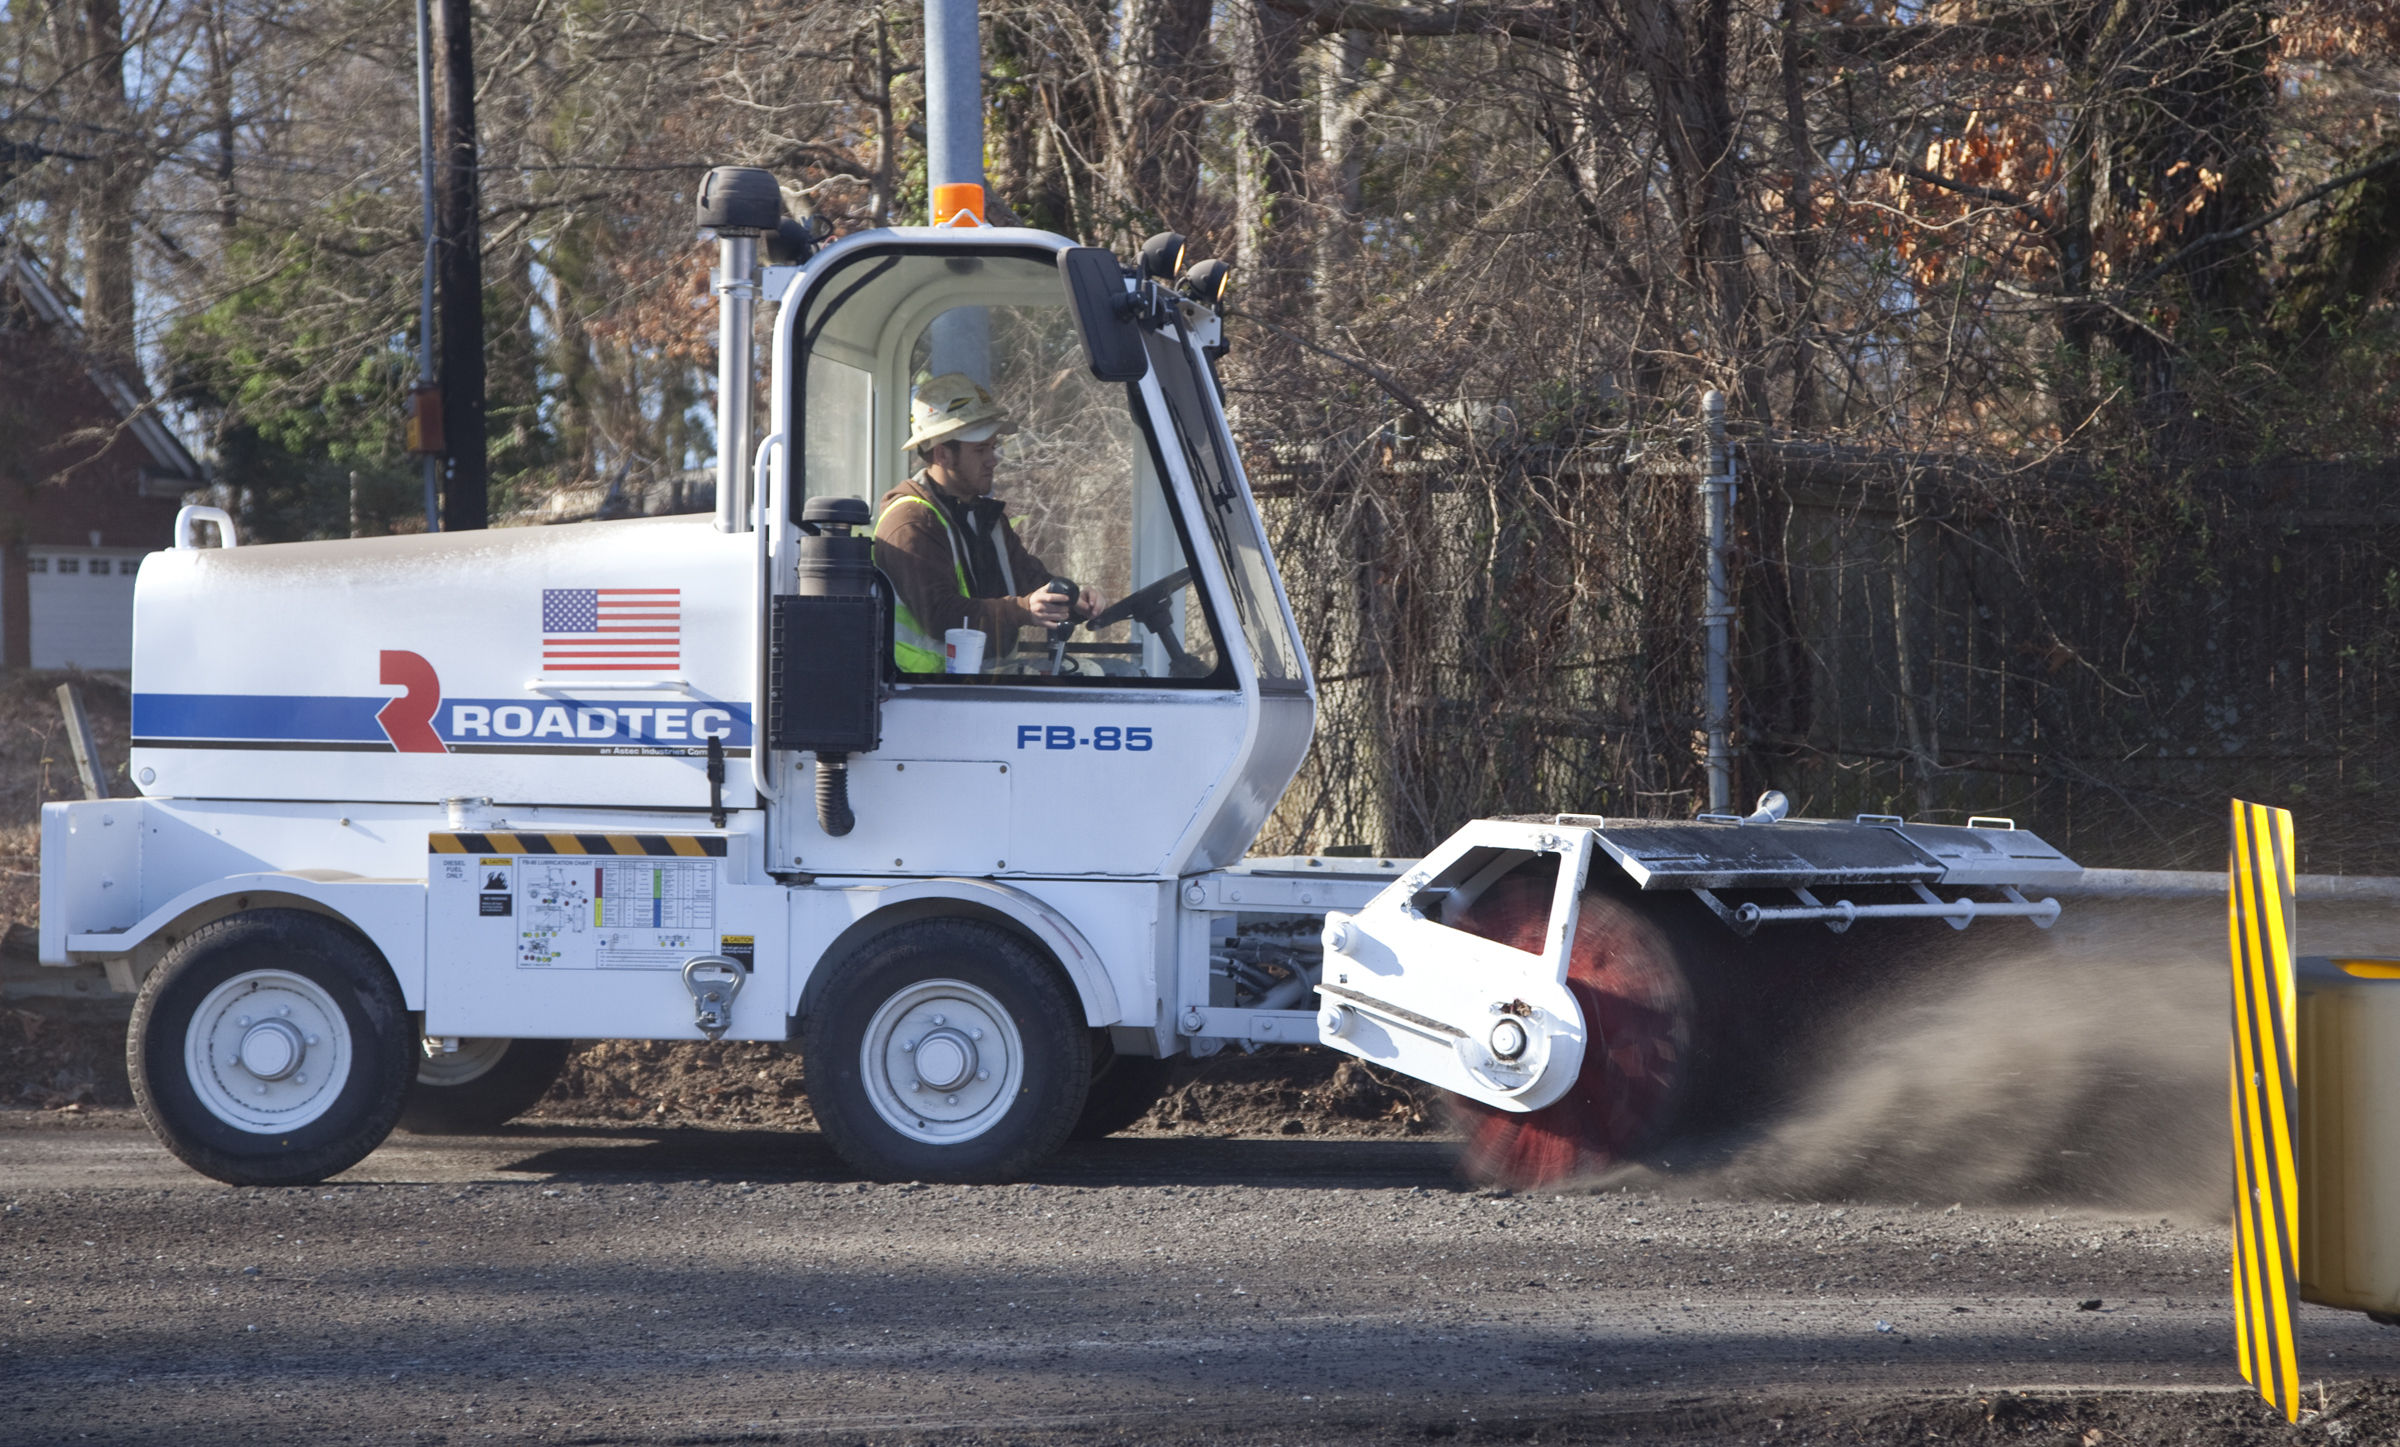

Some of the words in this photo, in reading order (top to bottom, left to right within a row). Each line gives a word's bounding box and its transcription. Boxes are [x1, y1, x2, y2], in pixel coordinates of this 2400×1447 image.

[452, 705, 731, 741] ROADTEC
[1017, 725, 1153, 751] FB-85
[613, 747, 639, 755] Astec
[641, 747, 685, 756] Industries
[687, 748, 729, 757] Comy
